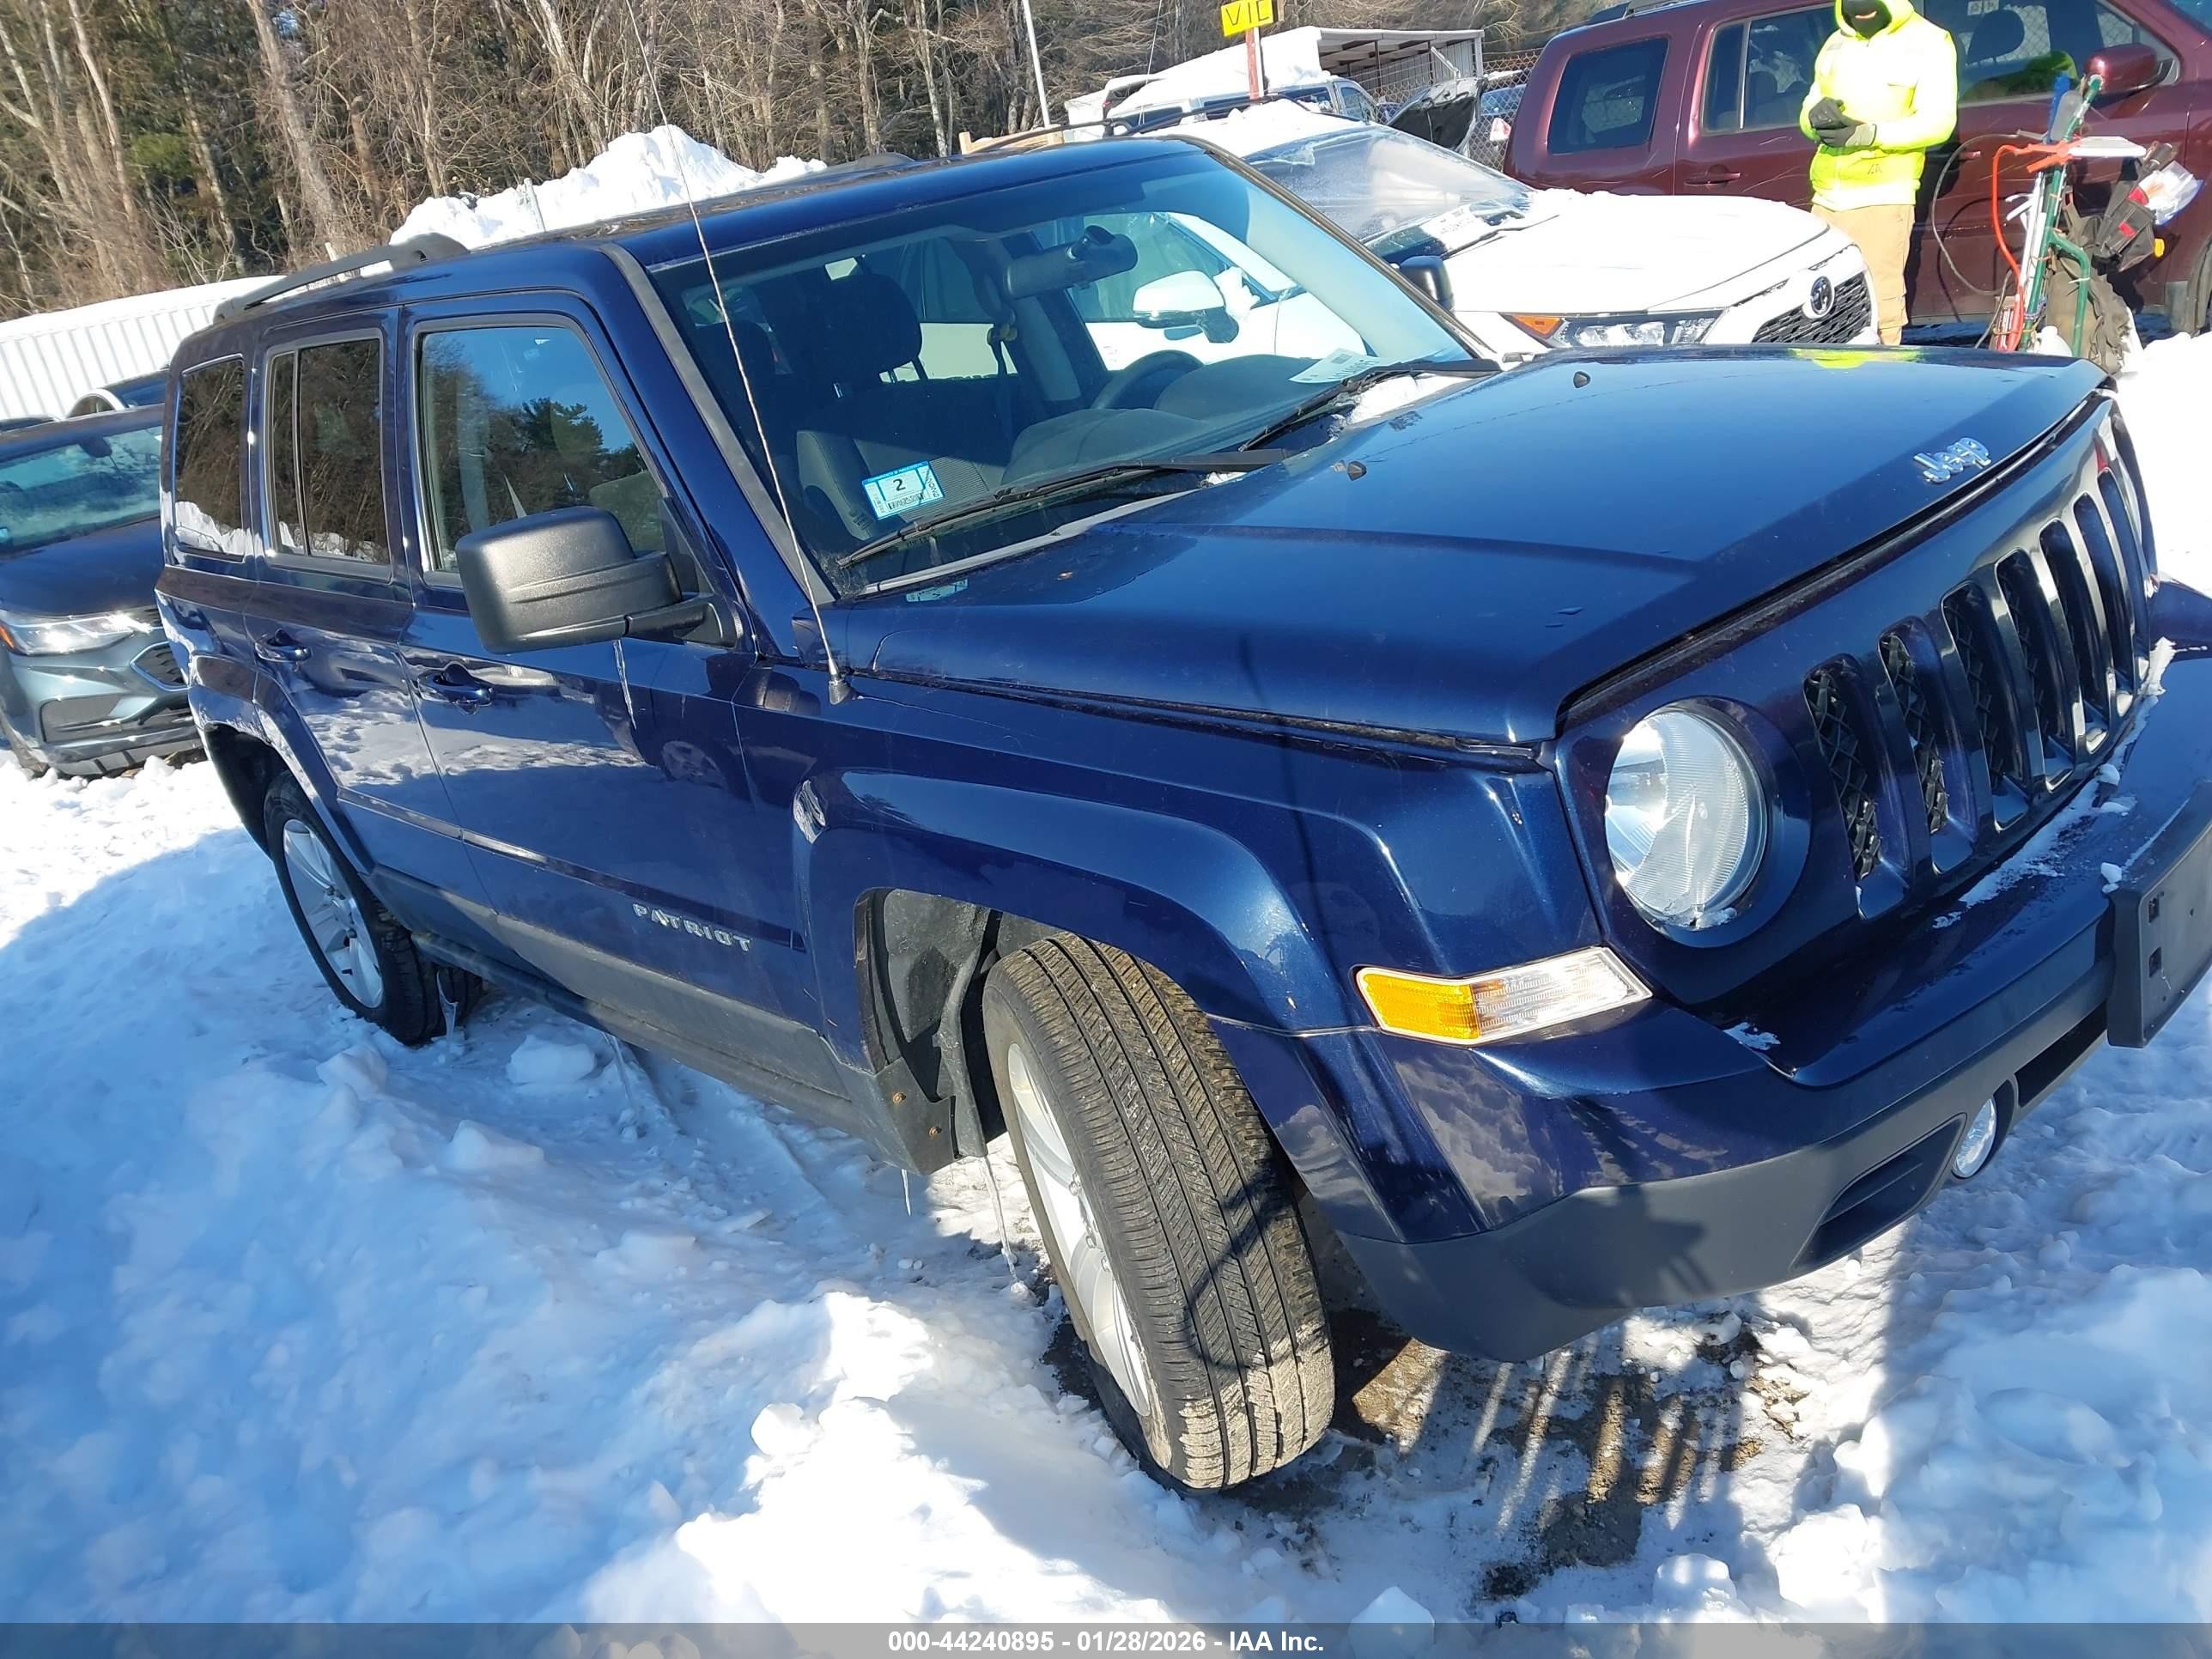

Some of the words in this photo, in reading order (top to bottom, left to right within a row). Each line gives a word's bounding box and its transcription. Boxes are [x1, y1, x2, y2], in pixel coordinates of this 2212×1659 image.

[1913, 437, 1992, 483] Jeep
[893, 478, 906, 491] 2
[632, 903, 752, 951] PATRIOT
